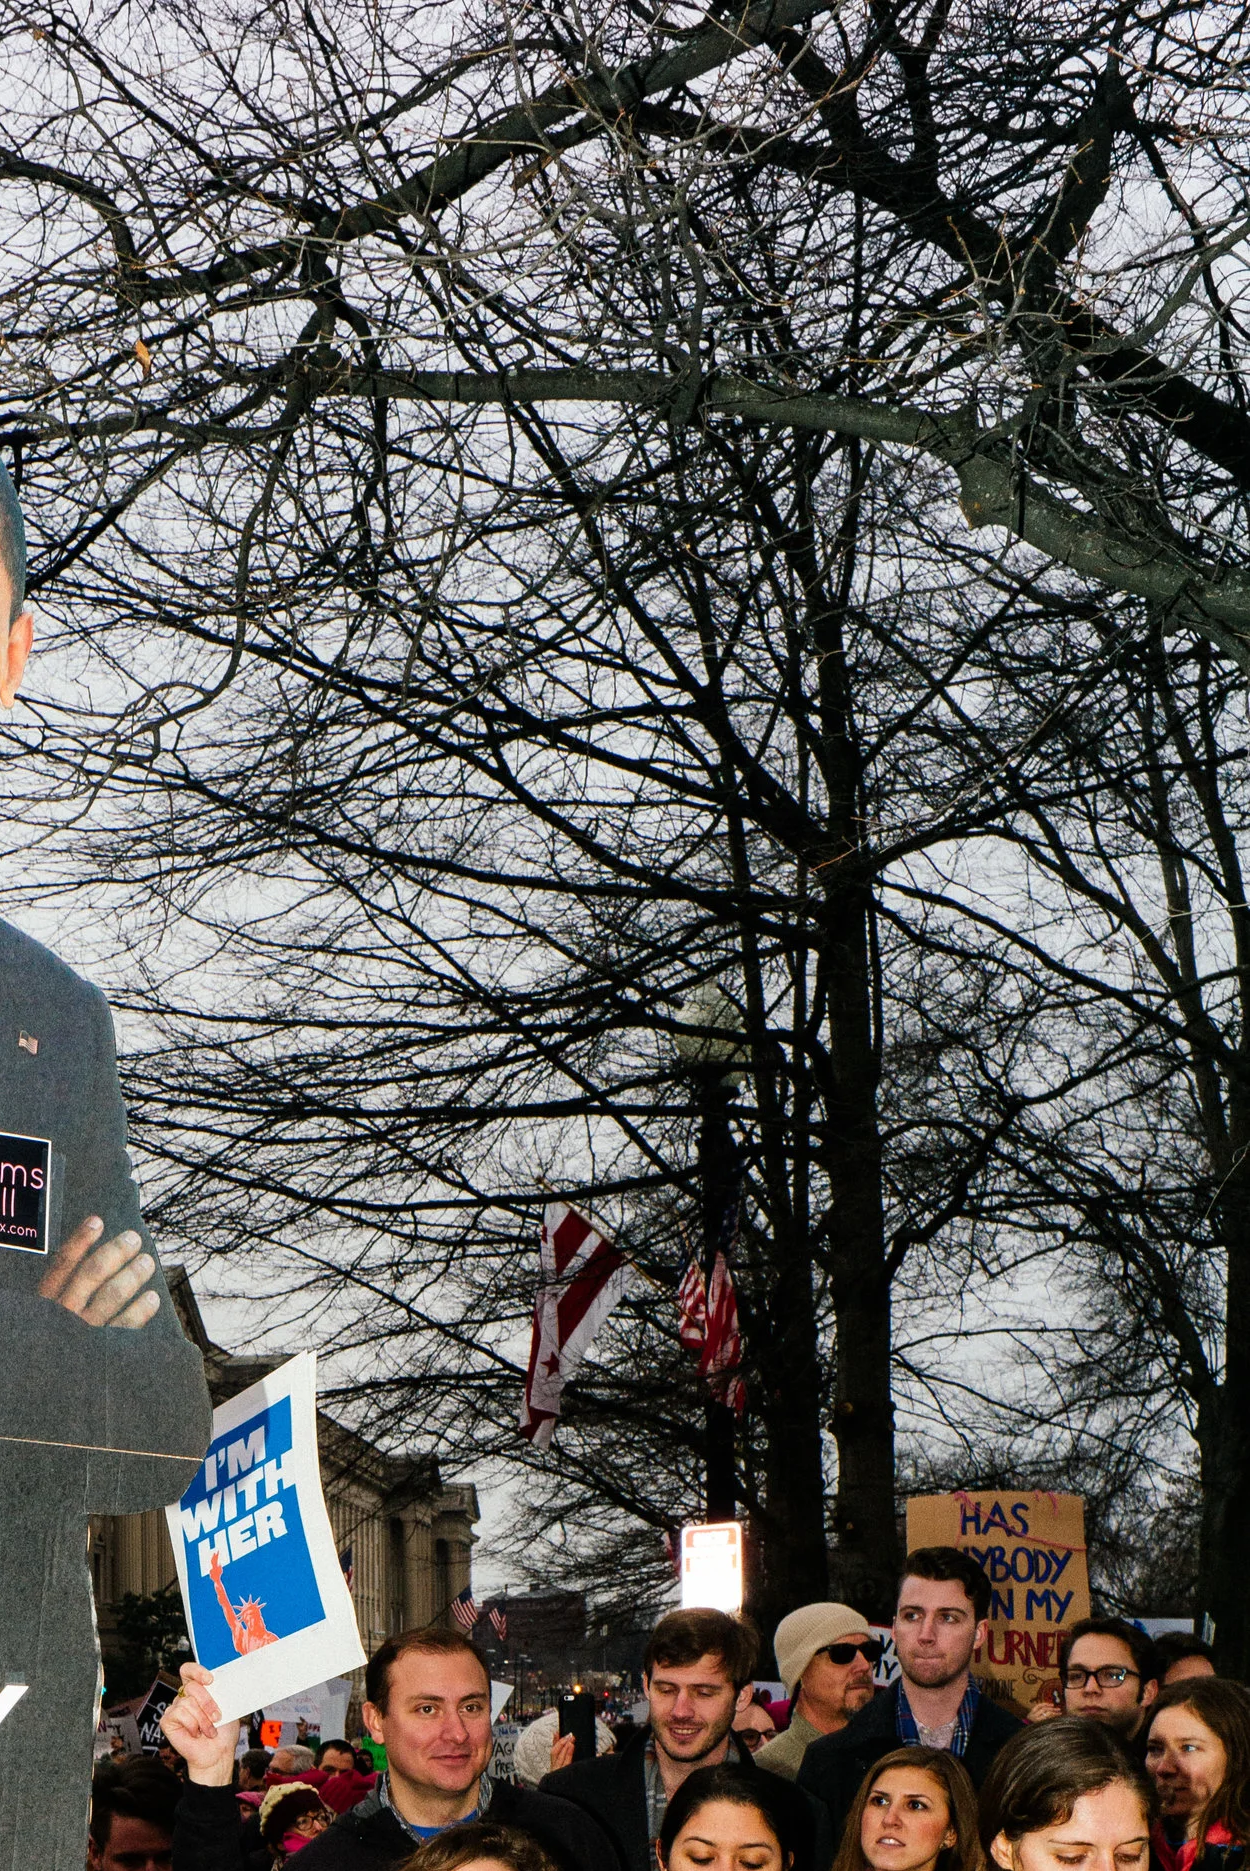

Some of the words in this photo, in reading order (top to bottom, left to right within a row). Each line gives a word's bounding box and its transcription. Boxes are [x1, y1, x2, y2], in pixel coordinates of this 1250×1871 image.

[204, 1425, 267, 1492] I'M
[180, 1448, 297, 1543] WITH
[960, 1500, 1030, 1538] HAS
[198, 1500, 288, 1577] HER
[964, 1546, 1073, 1585] YBODY
[1024, 1588, 1075, 1624] MY
